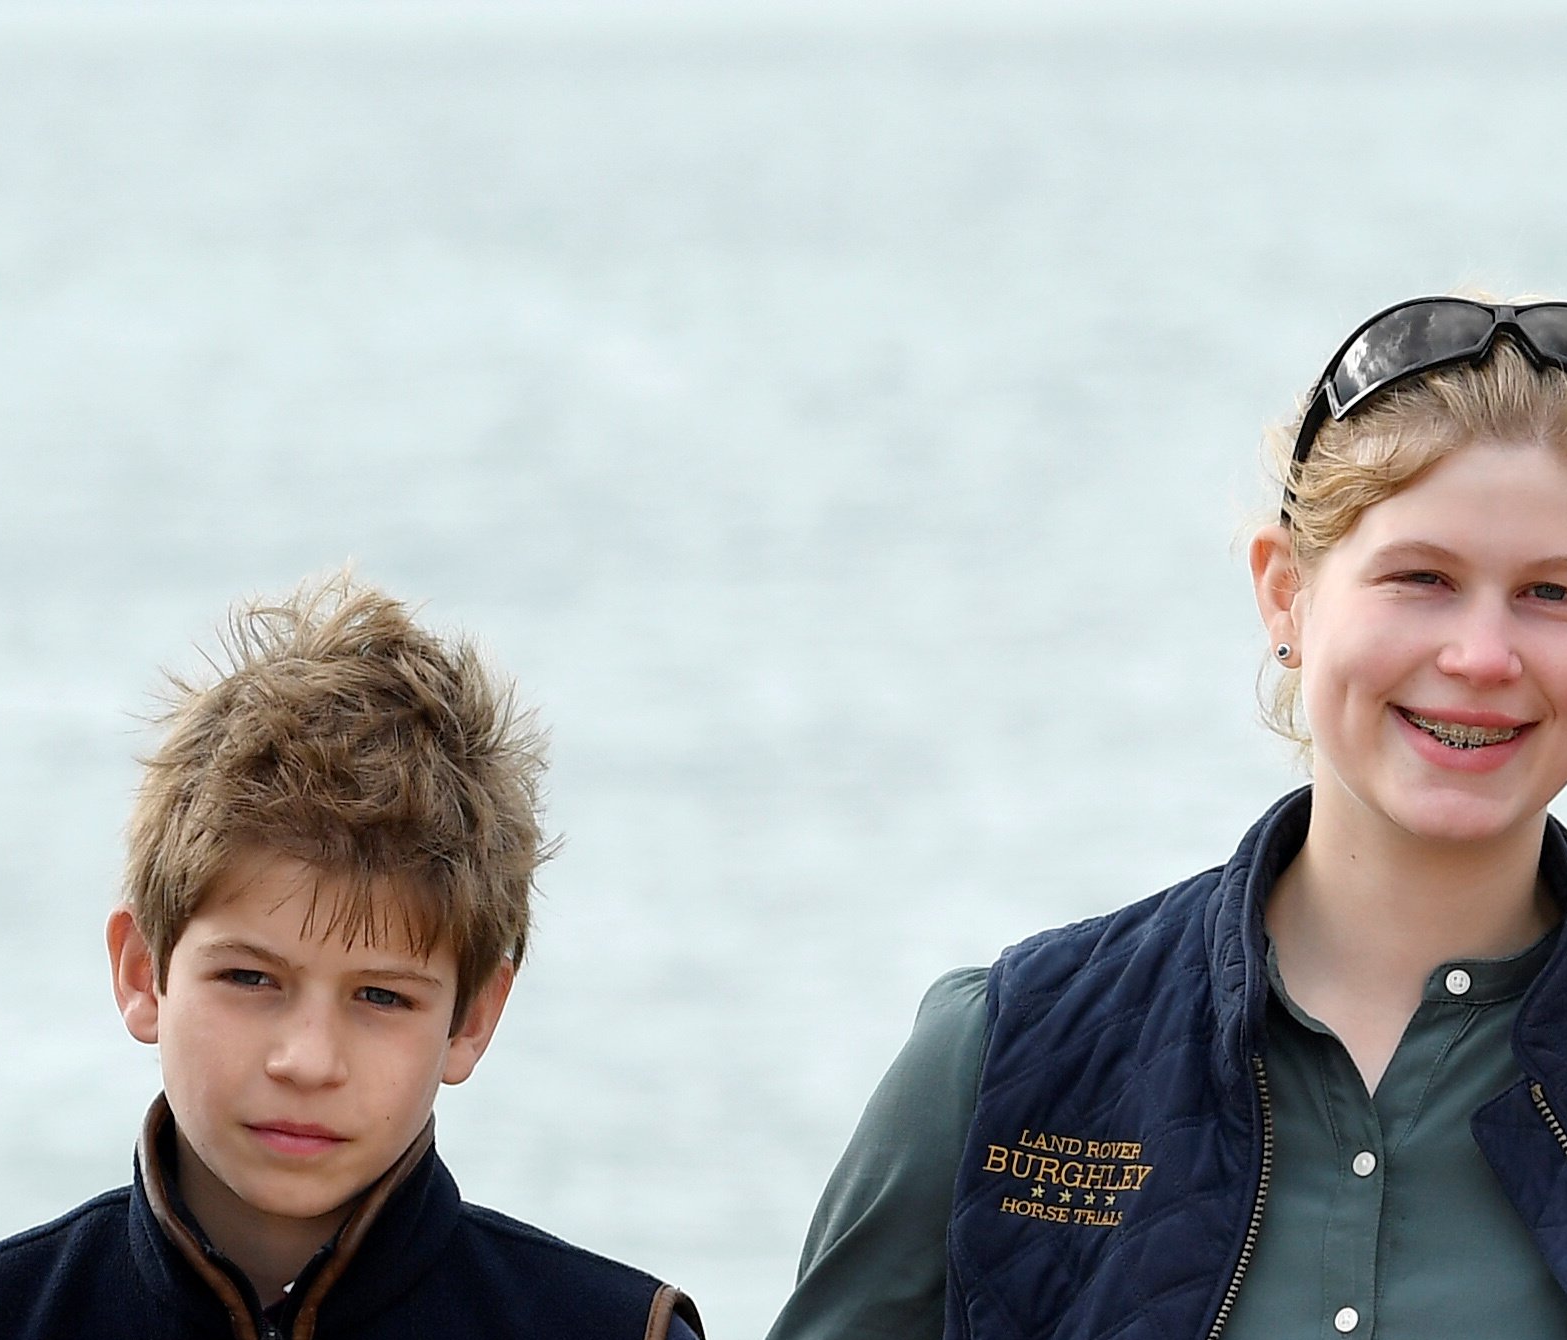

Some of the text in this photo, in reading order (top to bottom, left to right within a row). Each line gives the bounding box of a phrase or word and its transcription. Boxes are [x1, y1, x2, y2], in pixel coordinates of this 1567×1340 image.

[1018, 1129, 1143, 1160] LAND ROVER
[982, 1145, 1153, 1191] BURGHLEY
[1000, 1196, 1070, 1224] HORSE
